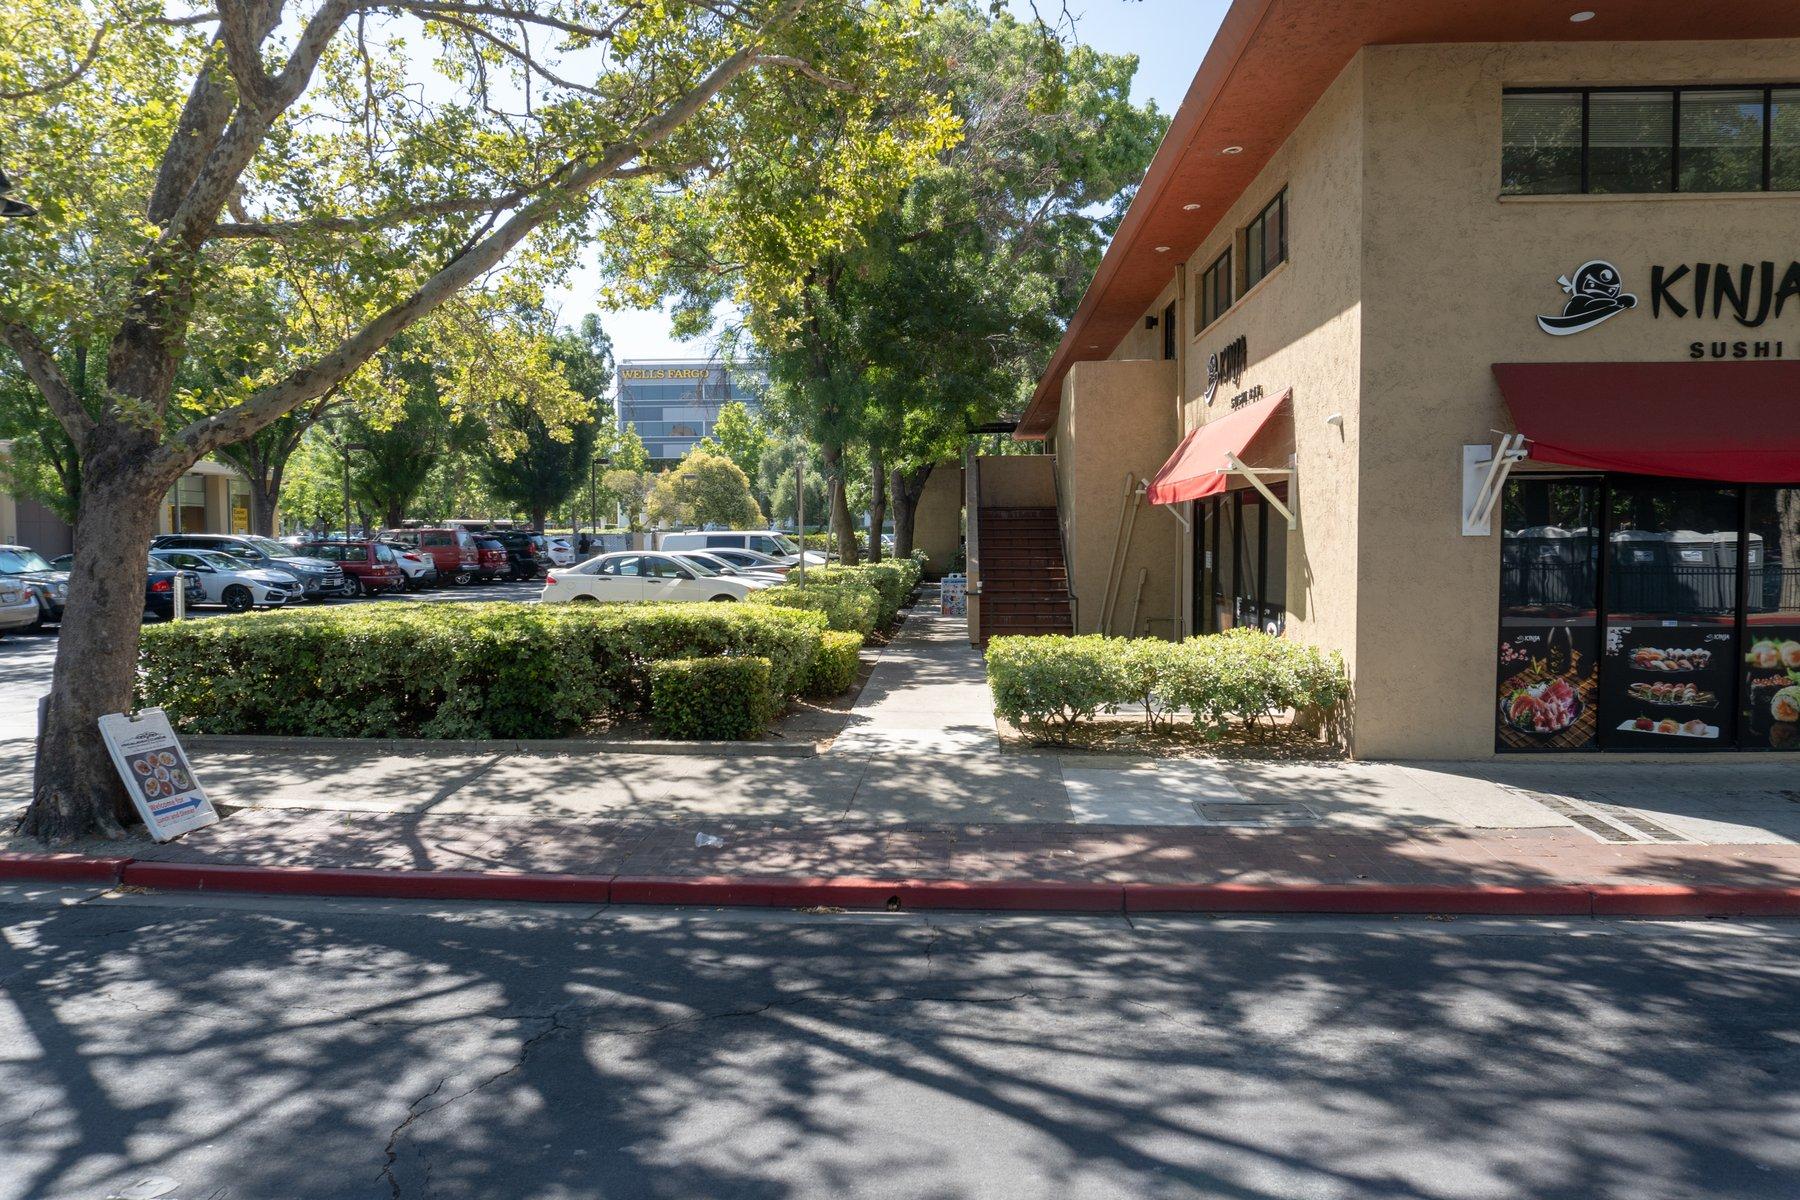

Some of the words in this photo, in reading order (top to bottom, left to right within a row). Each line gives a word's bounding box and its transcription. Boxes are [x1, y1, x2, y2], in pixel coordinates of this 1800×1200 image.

[1651, 261, 1800, 327] KINJA
[1690, 341, 1783, 358] SUSHI
[622, 368, 665, 378] WELLS
[668, 368, 709, 378] FARGO
